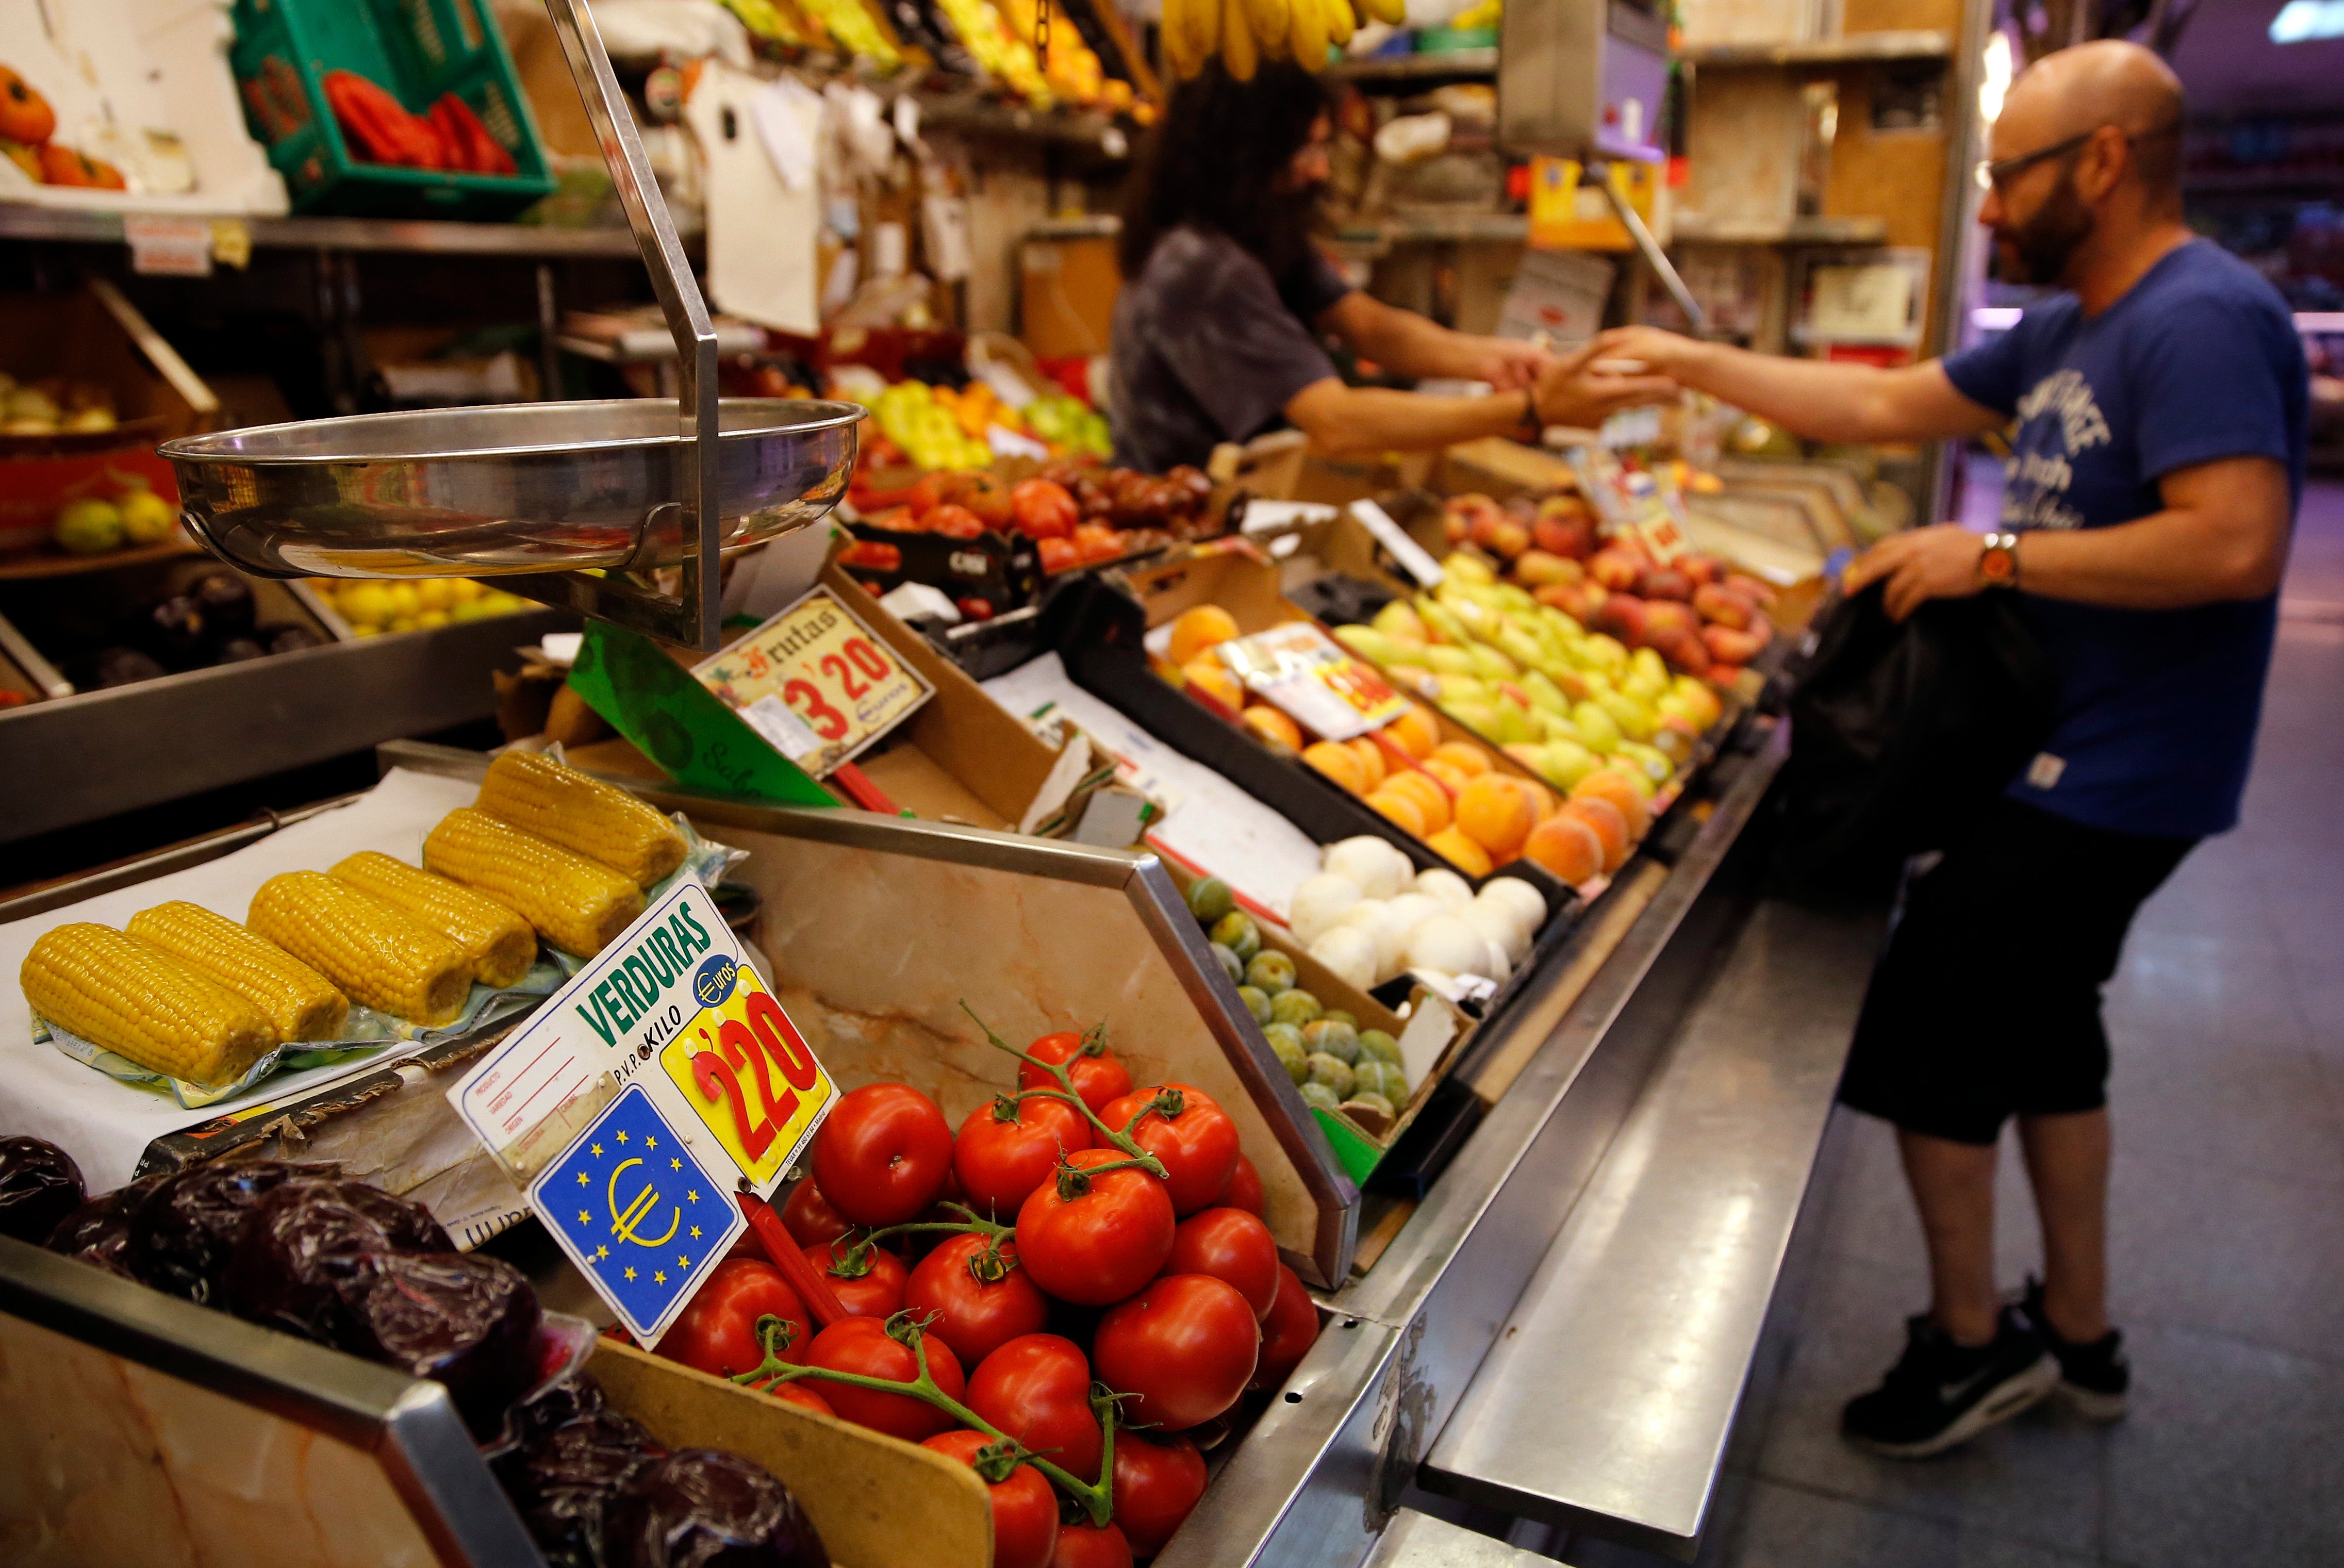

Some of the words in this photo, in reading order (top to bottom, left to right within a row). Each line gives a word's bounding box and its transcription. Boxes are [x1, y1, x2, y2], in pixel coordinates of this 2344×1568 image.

[740, 610, 837, 680] Frutas
[576, 901, 711, 1047] VERDURAS
[614, 1054, 640, 1085] P.V.P.
[644, 1005, 681, 1052] KILO
[475, 1071, 500, 1096] PRODUCTO
[490, 1092, 512, 1114] VARIEDAD
[505, 1116, 523, 1134] ORIGEN
[785, 1152, 796, 1166] TEVAR
[815, 1111, 826, 1124] Madrid
